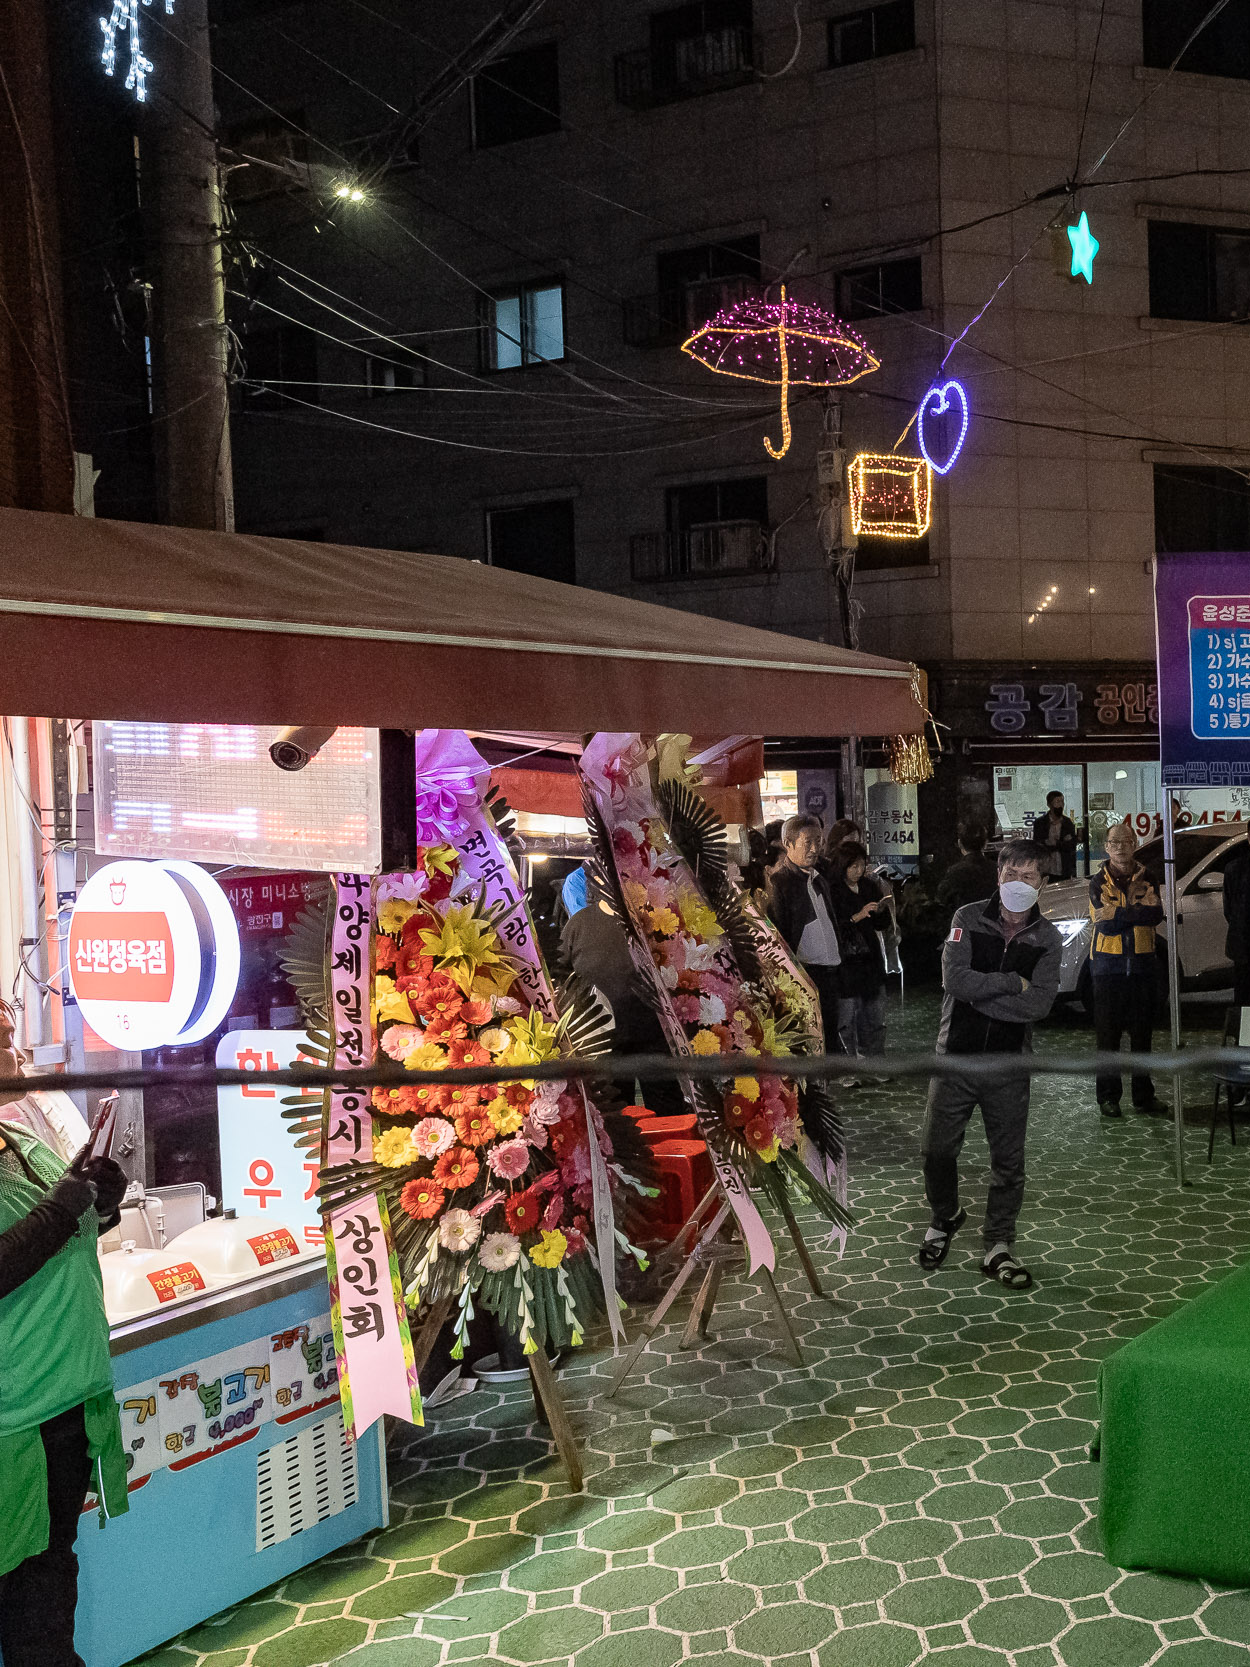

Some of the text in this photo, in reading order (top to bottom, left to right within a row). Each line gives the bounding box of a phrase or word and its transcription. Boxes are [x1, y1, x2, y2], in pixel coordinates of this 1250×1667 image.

[1203, 604, 1250, 622] 윤성준
[1207, 634, 1220, 649] 1)
[1224, 635, 1236, 652] sj
[1207, 654, 1222, 669] 2)
[1208, 673, 1223, 689] 3)
[985, 683, 1083, 732] 공감
[1209, 693, 1224, 709] 4)
[868, 809, 914, 824] 감부동산
[866, 830, 915, 844] 91-2454
[76, 939, 167, 975] 신원정육점
[154, 1269, 199, 1291] 간장불고기
[335, 1214, 385, 1343] 상인회
